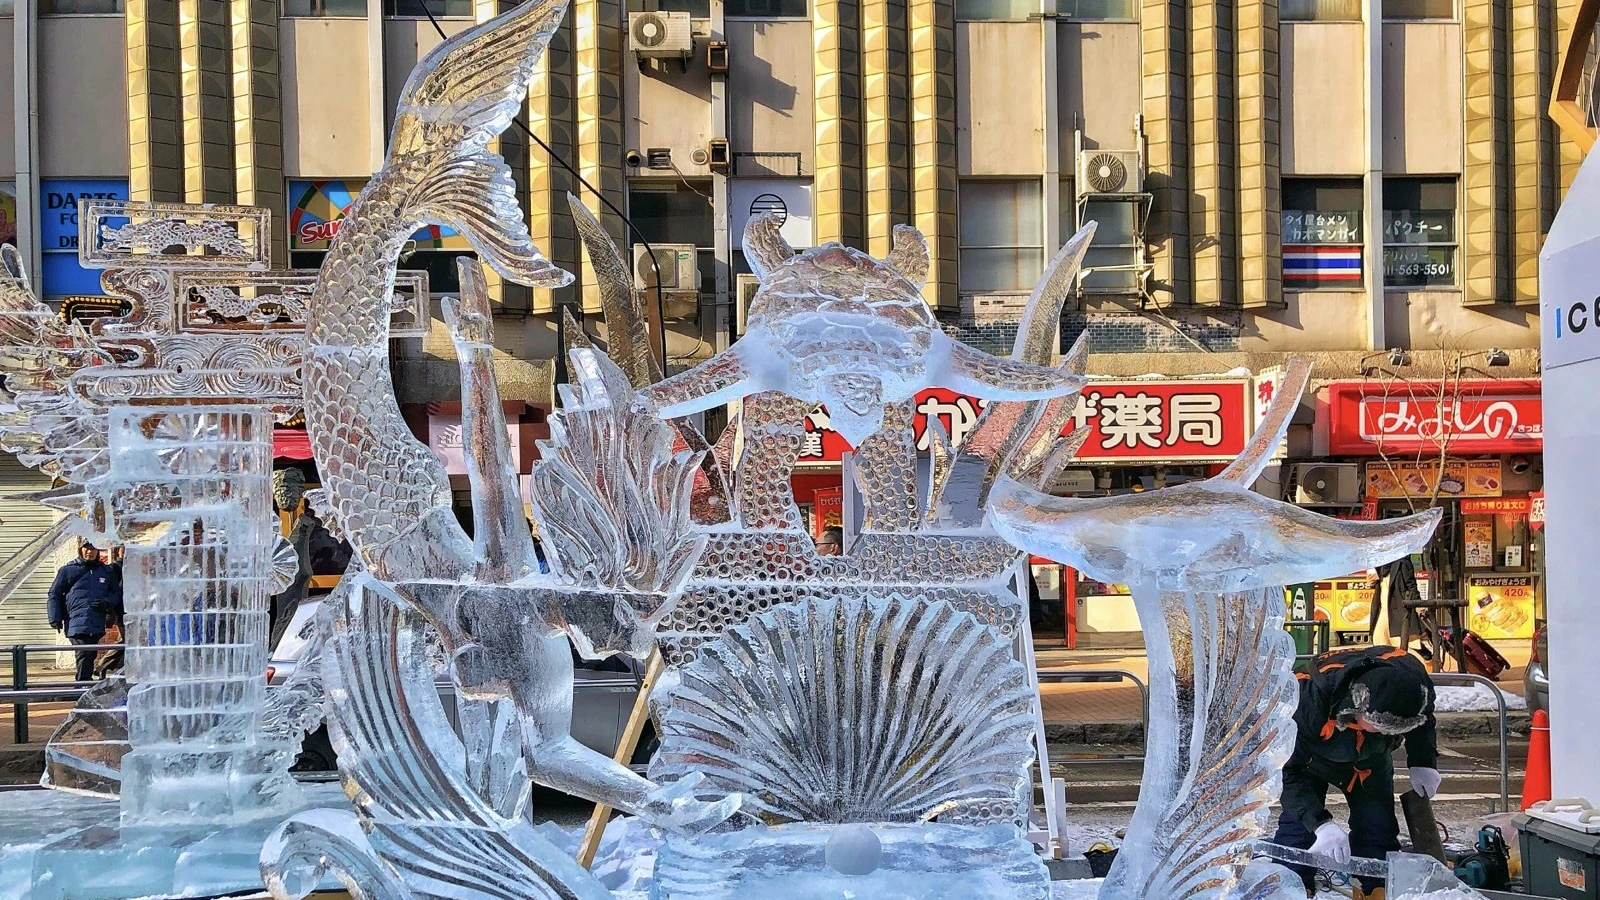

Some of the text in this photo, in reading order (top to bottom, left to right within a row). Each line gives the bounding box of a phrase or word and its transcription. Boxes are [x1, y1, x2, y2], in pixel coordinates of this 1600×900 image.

[60, 213, 108, 225] FOD
[1285, 214, 1347, 226] タイ屋台メシ
[1292, 227, 1358, 240] カオマンガイ
[1385, 220, 1443, 235] パクチー
[1377, 398, 1518, 440] みよしの
[1464, 501, 1526, 510] お持ち帰り注文口
[1474, 578, 1527, 586] おみやげぎょうざ
